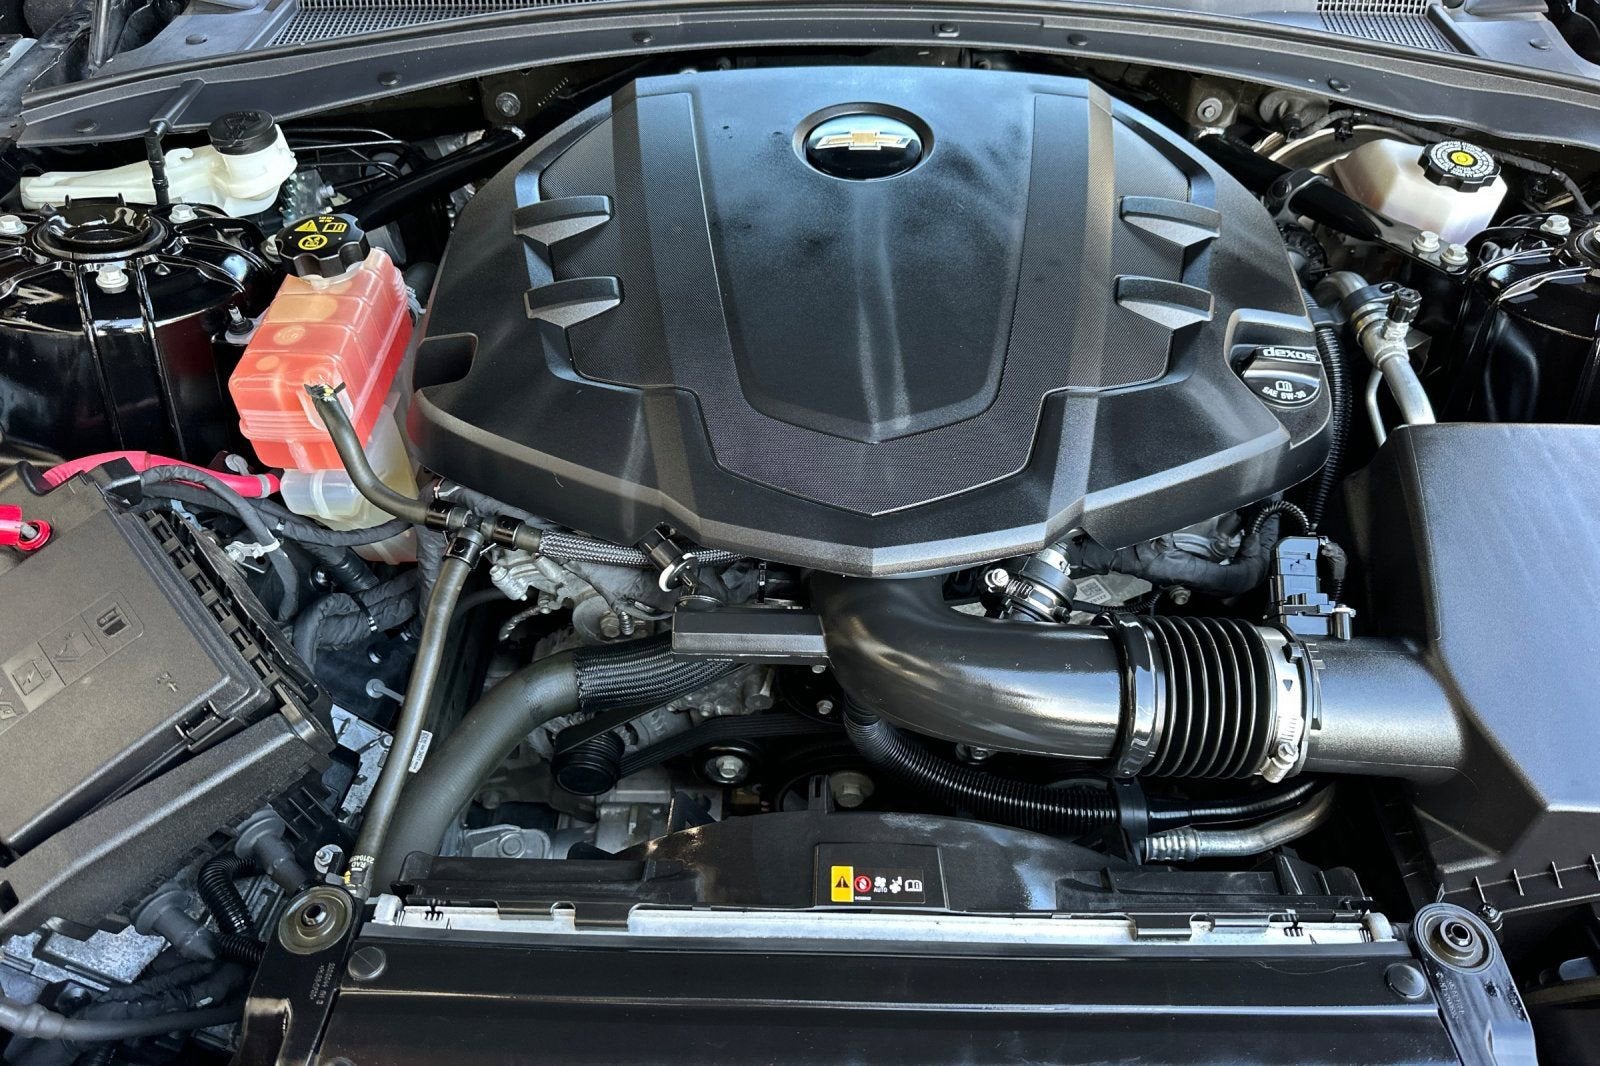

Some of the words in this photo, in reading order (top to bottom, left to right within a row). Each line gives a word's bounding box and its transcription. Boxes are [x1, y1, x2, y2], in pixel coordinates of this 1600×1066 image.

[1262, 347, 1316, 362] dexos
[1262, 386, 1278, 398] SAE
[1280, 390, 1306, 400] 5W-30
